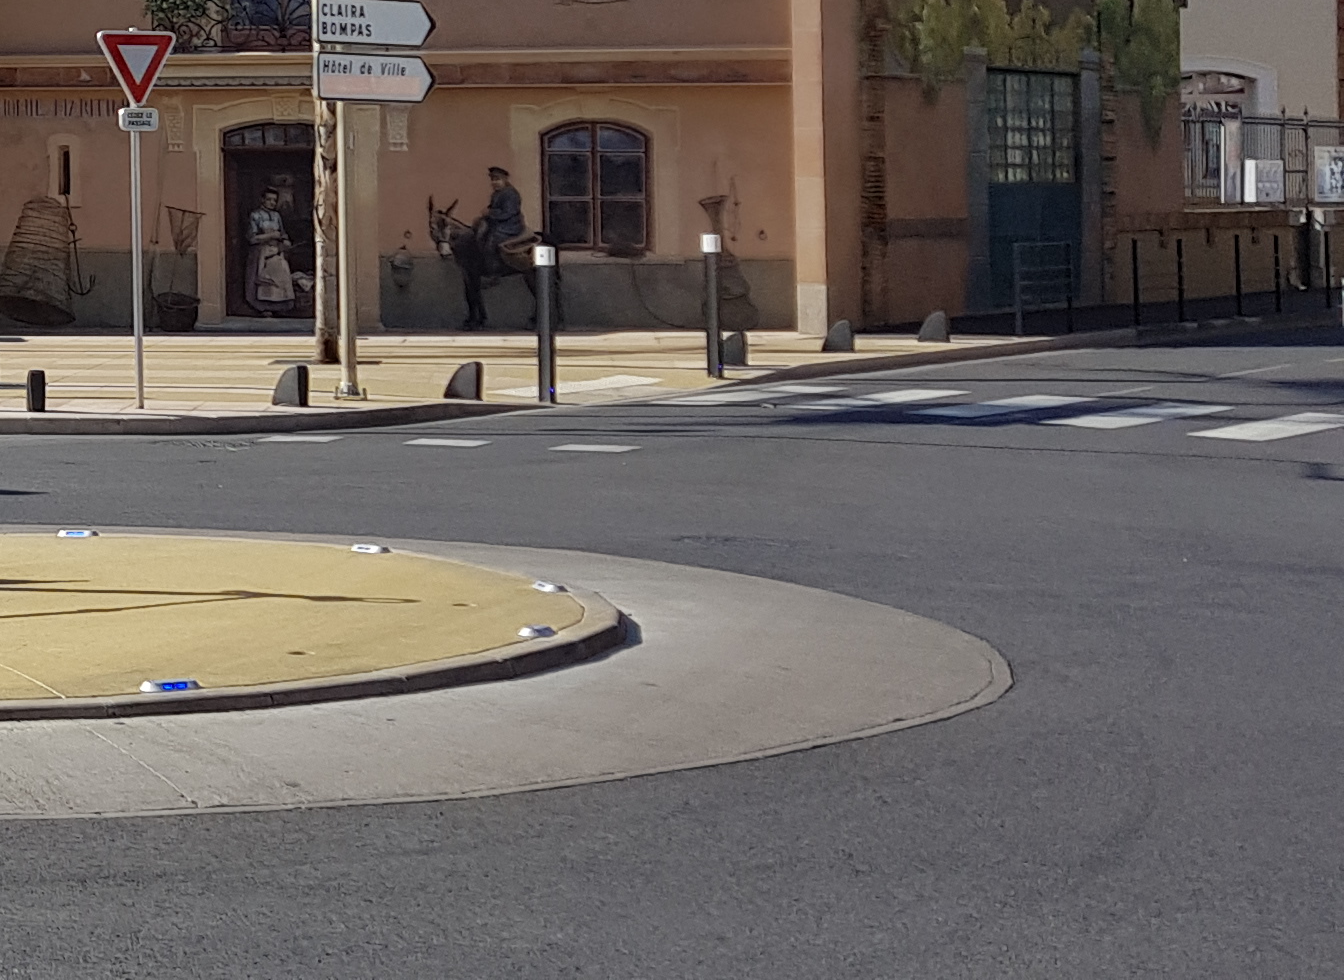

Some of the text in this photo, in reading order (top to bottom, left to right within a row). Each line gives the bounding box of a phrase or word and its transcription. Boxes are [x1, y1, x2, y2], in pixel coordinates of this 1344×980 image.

[321, 3, 366, 19] CLAIRA
[321, 22, 372, 37] BOMPAS
[322, 59, 407, 77] Hôtel de Ville
